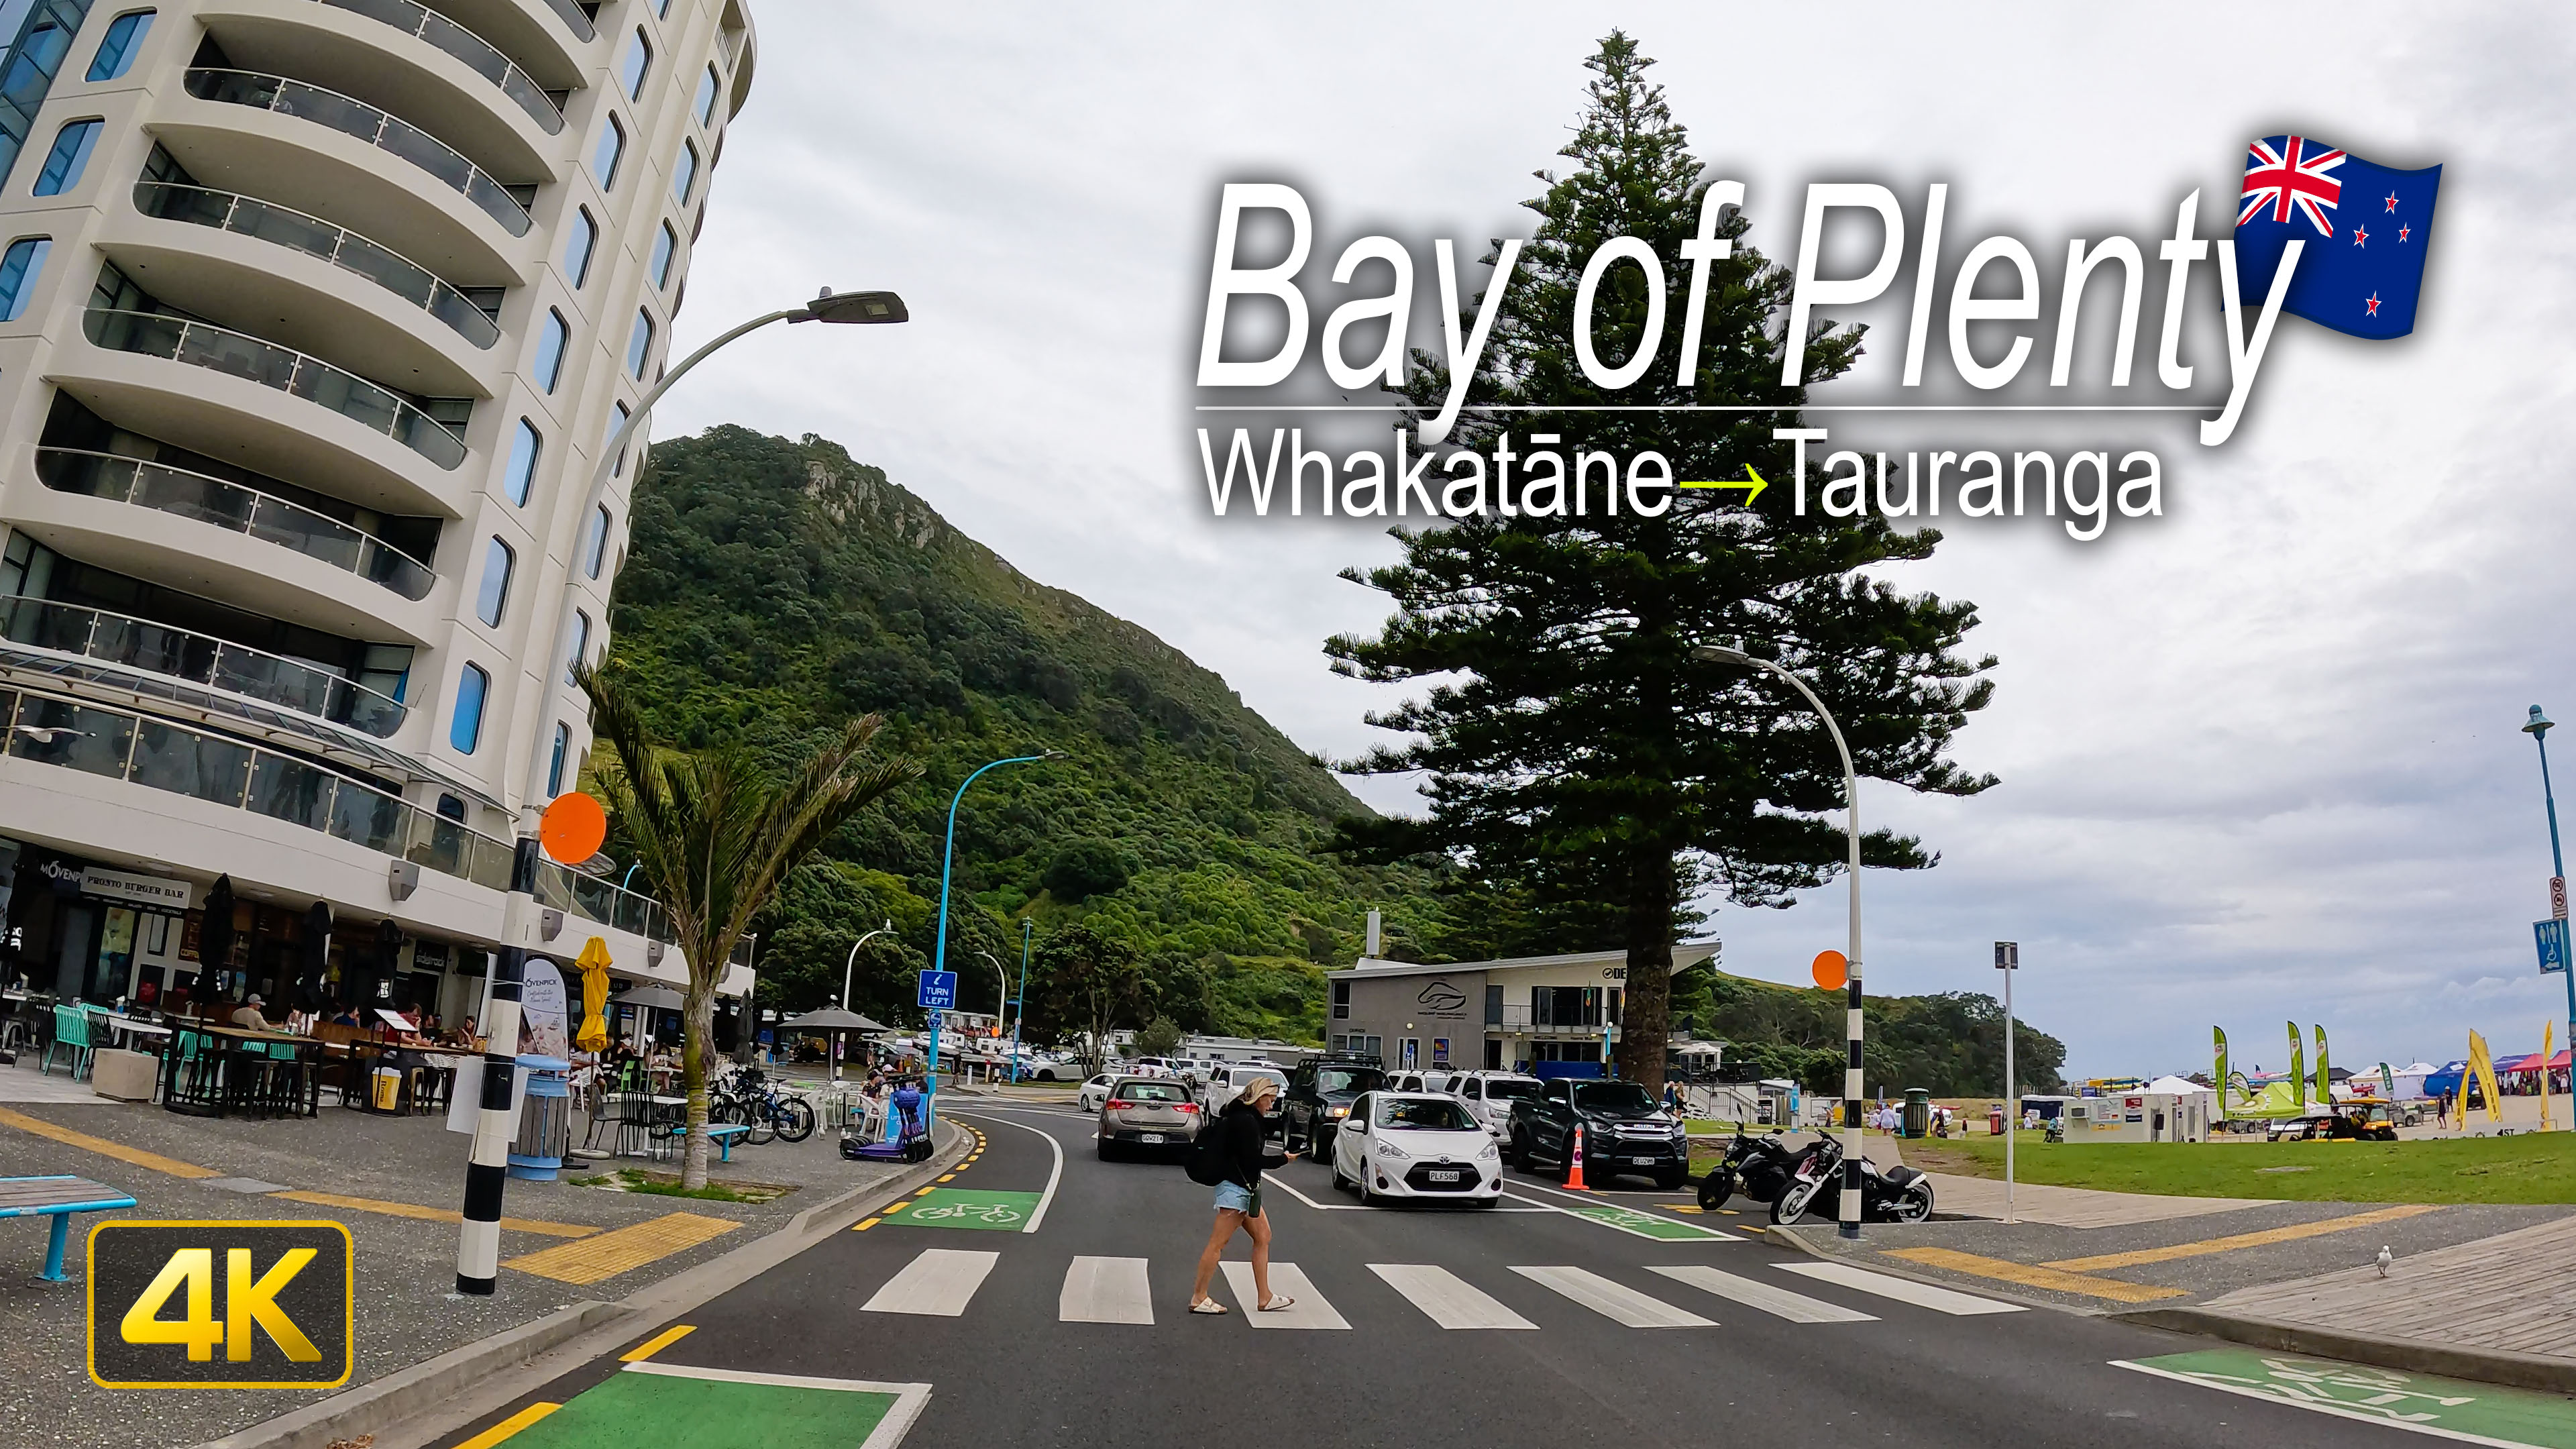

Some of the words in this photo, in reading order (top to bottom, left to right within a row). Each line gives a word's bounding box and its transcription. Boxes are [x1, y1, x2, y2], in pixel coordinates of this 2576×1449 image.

[164, 889, 184, 899] BAR
[926, 987, 949, 996] TURN
[925, 996, 949, 1006] LEFT
[1430, 1172, 1458, 1181] PLF568
